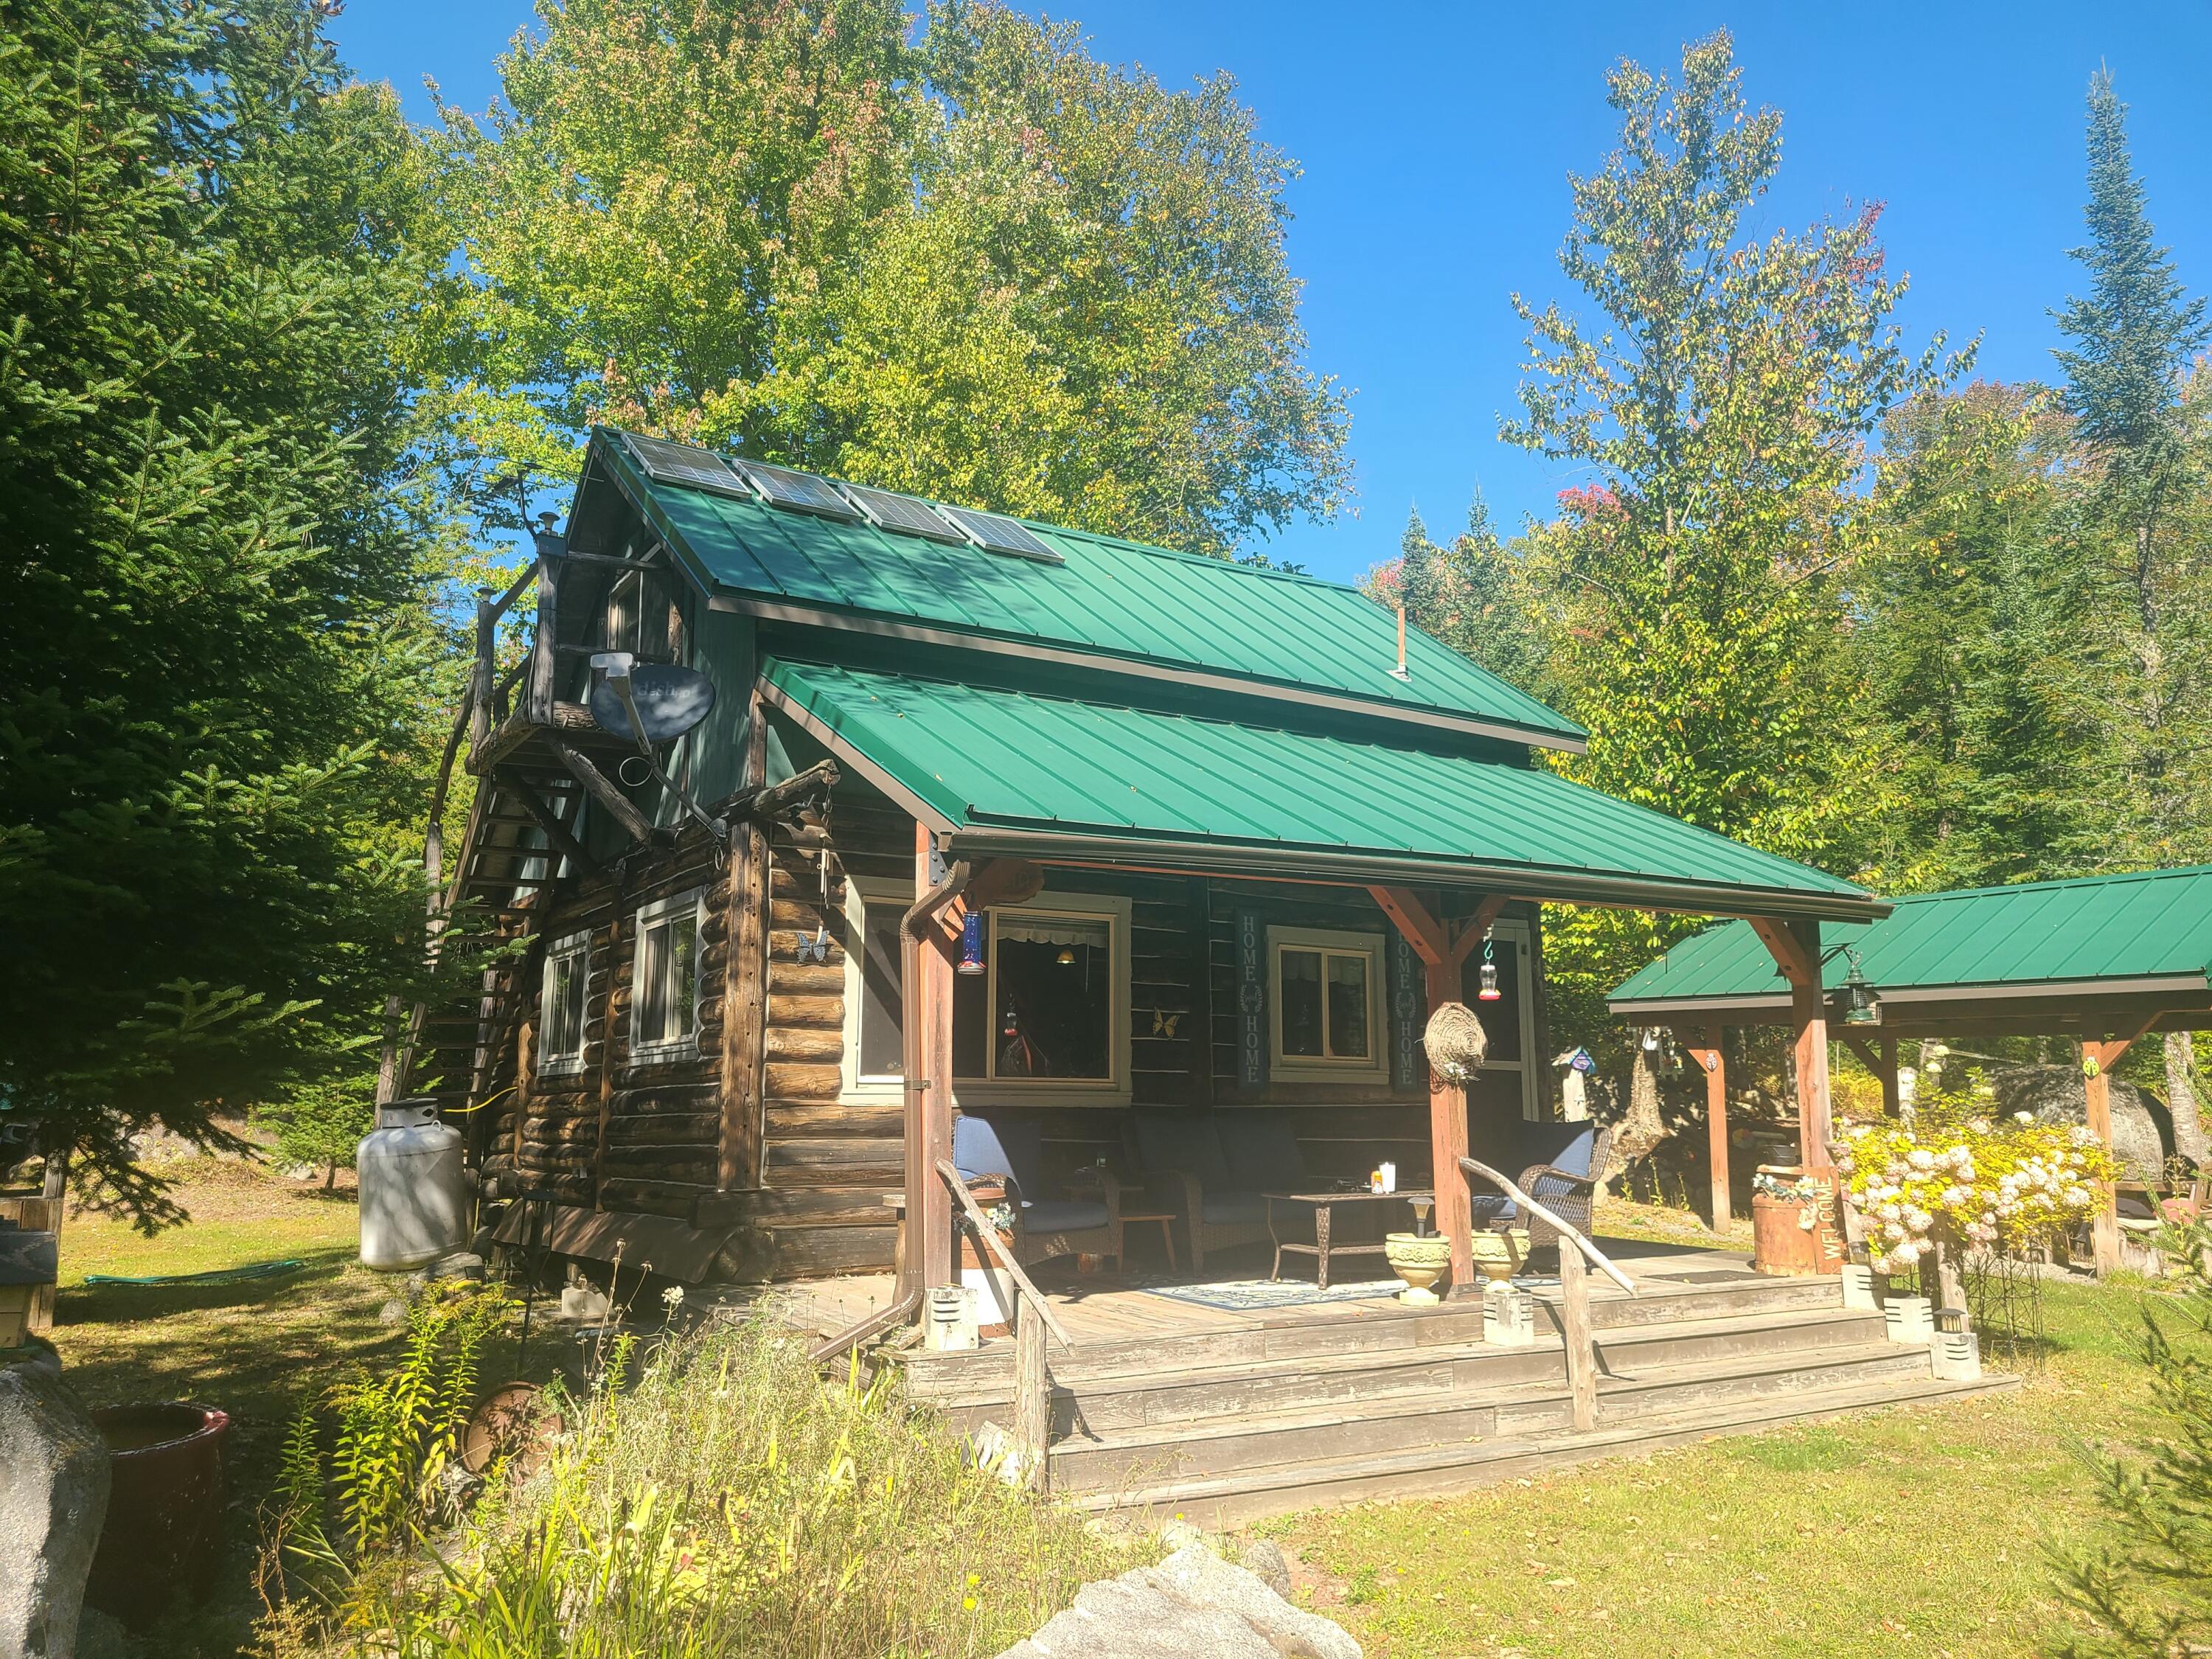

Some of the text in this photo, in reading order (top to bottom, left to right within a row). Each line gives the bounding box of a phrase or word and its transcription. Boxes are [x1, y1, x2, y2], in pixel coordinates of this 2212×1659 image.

[637, 680, 675, 697] dish
[1244, 917, 1256, 981] HOME
[1246, 1016, 1259, 1082] HOME
[1401, 1021, 1413, 1084] HOME
